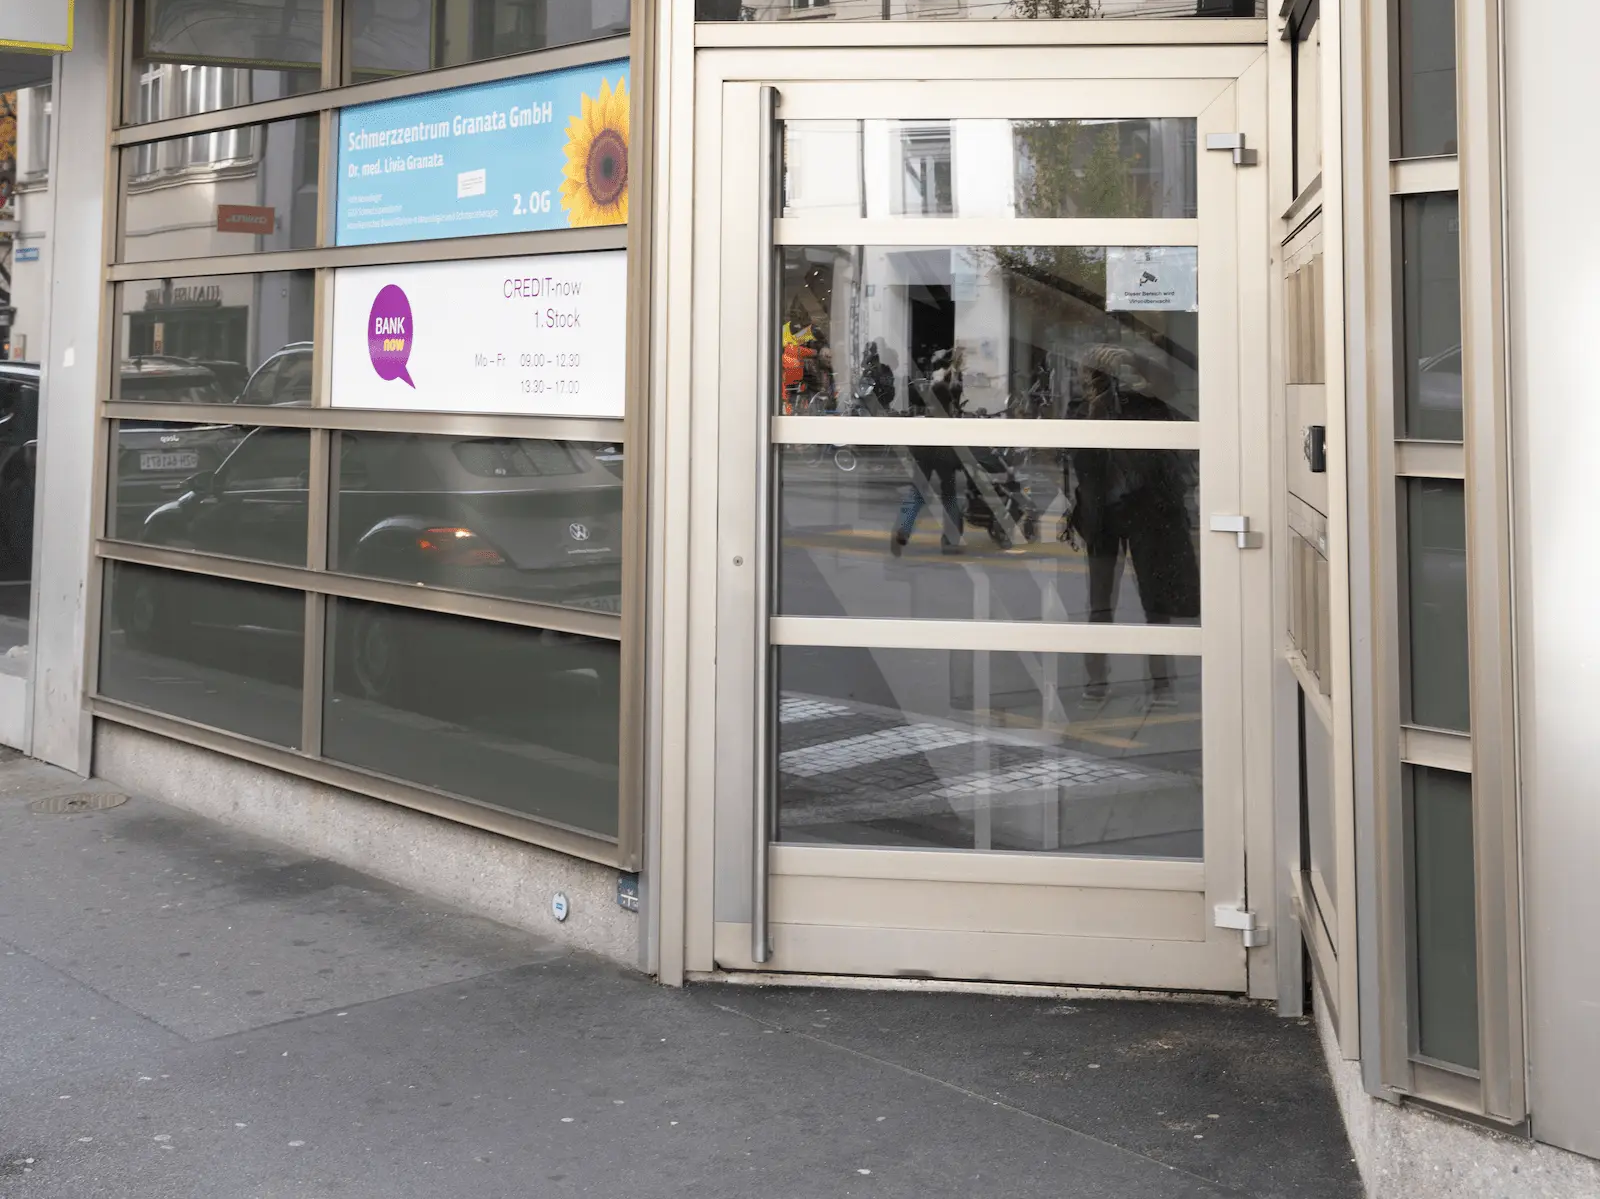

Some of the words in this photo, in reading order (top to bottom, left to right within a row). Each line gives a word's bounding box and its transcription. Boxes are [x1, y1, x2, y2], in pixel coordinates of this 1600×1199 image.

[348, 121, 450, 151] Schmerzzentrum
[453, 111, 507, 136] Granata
[509, 101, 553, 128] GmbH
[348, 163, 360, 179] Dr.
[362, 160, 383, 177] med.
[384, 156, 405, 173] Livia
[406, 152, 444, 171] Granata
[503, 277, 582, 299] CREDIT-now
[375, 316, 406, 335] BANK
[546, 307, 581, 328] Stock
[383, 337, 405, 352] now
[555, 380, 580, 395] 17.00
